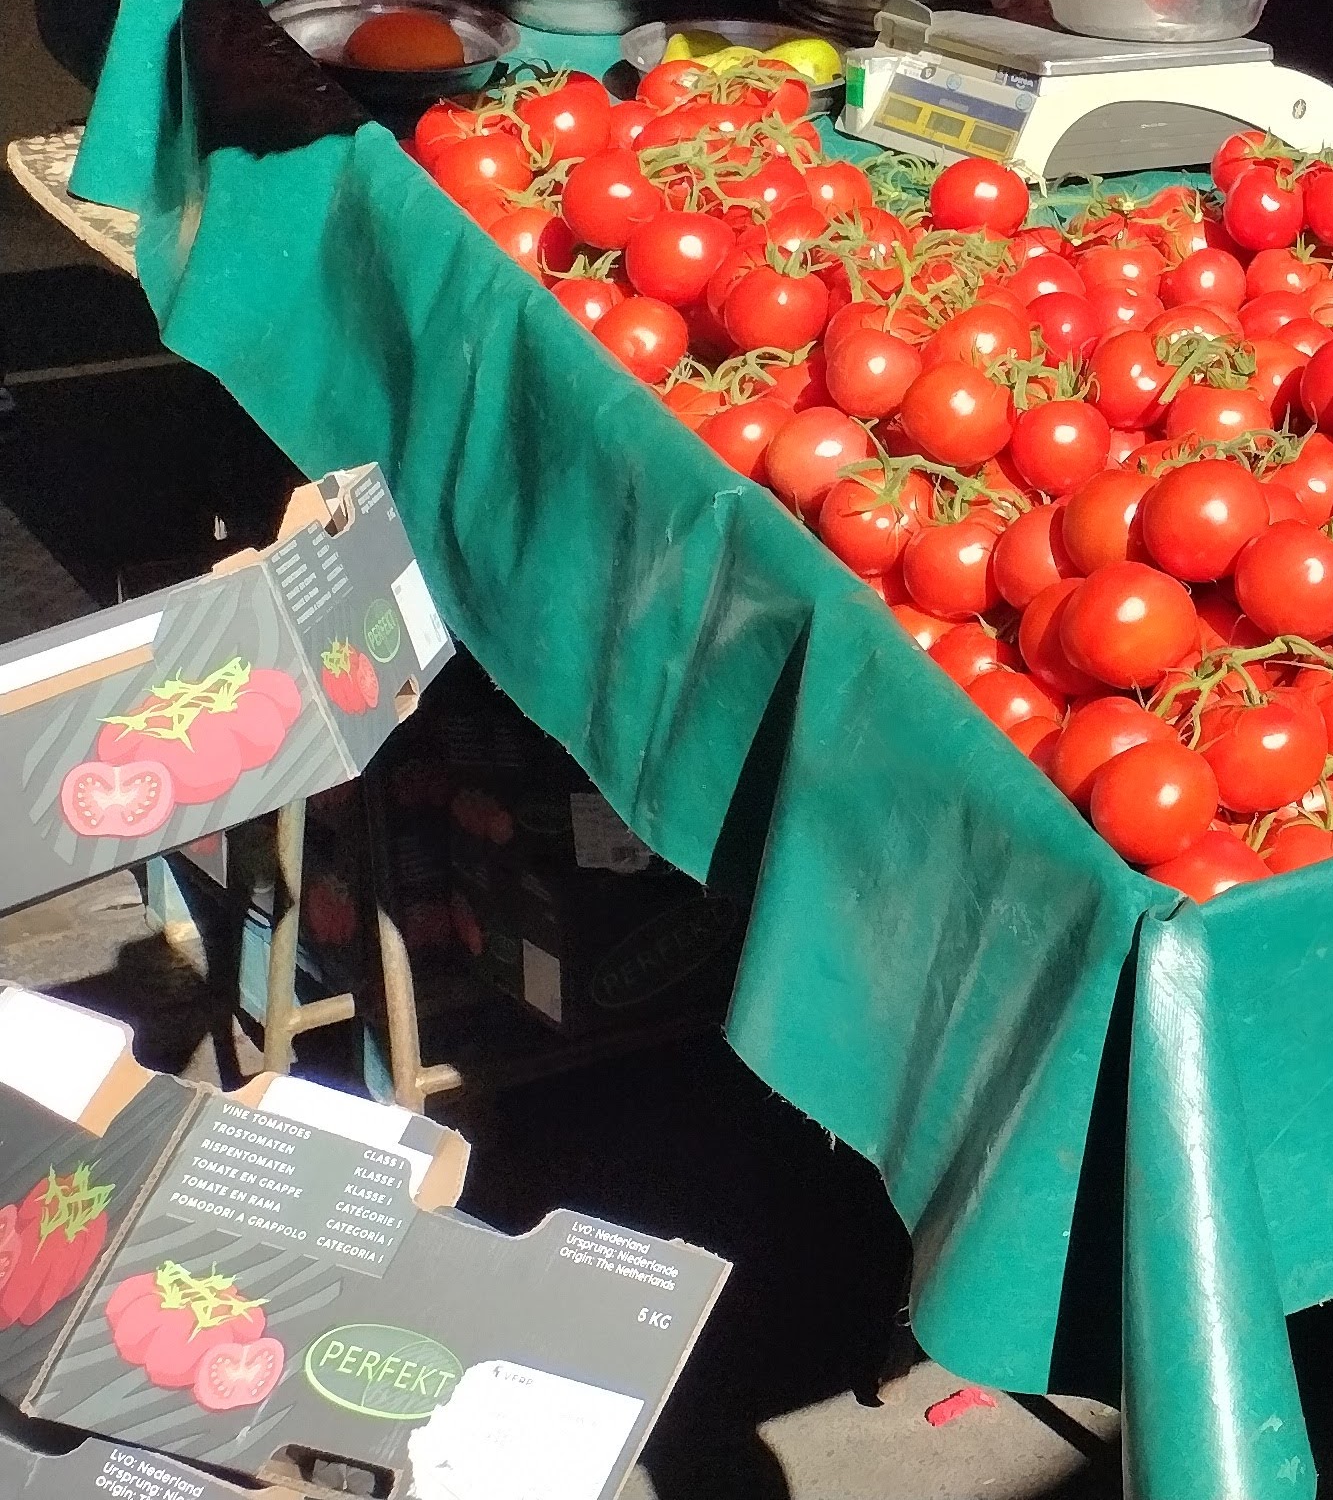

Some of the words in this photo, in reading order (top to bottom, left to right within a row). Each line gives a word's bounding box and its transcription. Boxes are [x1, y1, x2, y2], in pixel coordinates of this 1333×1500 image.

[212, 1120, 296, 1155] TROSTOMATEN
[222, 1103, 251, 1121] VINE
[252, 1112, 312, 1140] TOMATOES
[200, 1138, 296, 1175] RISPENTOMATEN
[363, 1149, 397, 1167] CLASS
[182, 1174, 229, 1197] TOMATE
[229, 1185, 248, 1202] EN
[250, 1195, 281, 1213] RAMA
[192, 1156, 239, 1180] TOMATE
[239, 1167, 258, 1185] EN
[258, 1177, 303, 1199] GRAPPE
[344, 1183, 387, 1205] KLASSE
[354, 1166, 396, 1188] KLASSE
[169, 1192, 236, 1219] POMODORI
[235, 1212, 245, 1224] A
[247, 1215, 307, 1241] GRAPPOLO
[335, 1200, 396, 1227] CATÉGORIE
[316, 1236, 377, 1263] CATEGORIA
[566, 1233, 616, 1259] Ursprung:
[616, 1249, 679, 1278] Niederlande
[595, 1228, 650, 1255] Nederland
[559, 1246, 595, 1266] Origin:
[596, 1257, 615, 1272] The
[615, 1264, 676, 1291] Netherlands
[637, 1307, 649, 1323] 5
[649, 1311, 673, 1330] KG
[319, 1340, 455, 1398] PERFEKT
[102, 1461, 165, 1498] Ursprung:
[137, 1460, 205, 1498] Nederland
